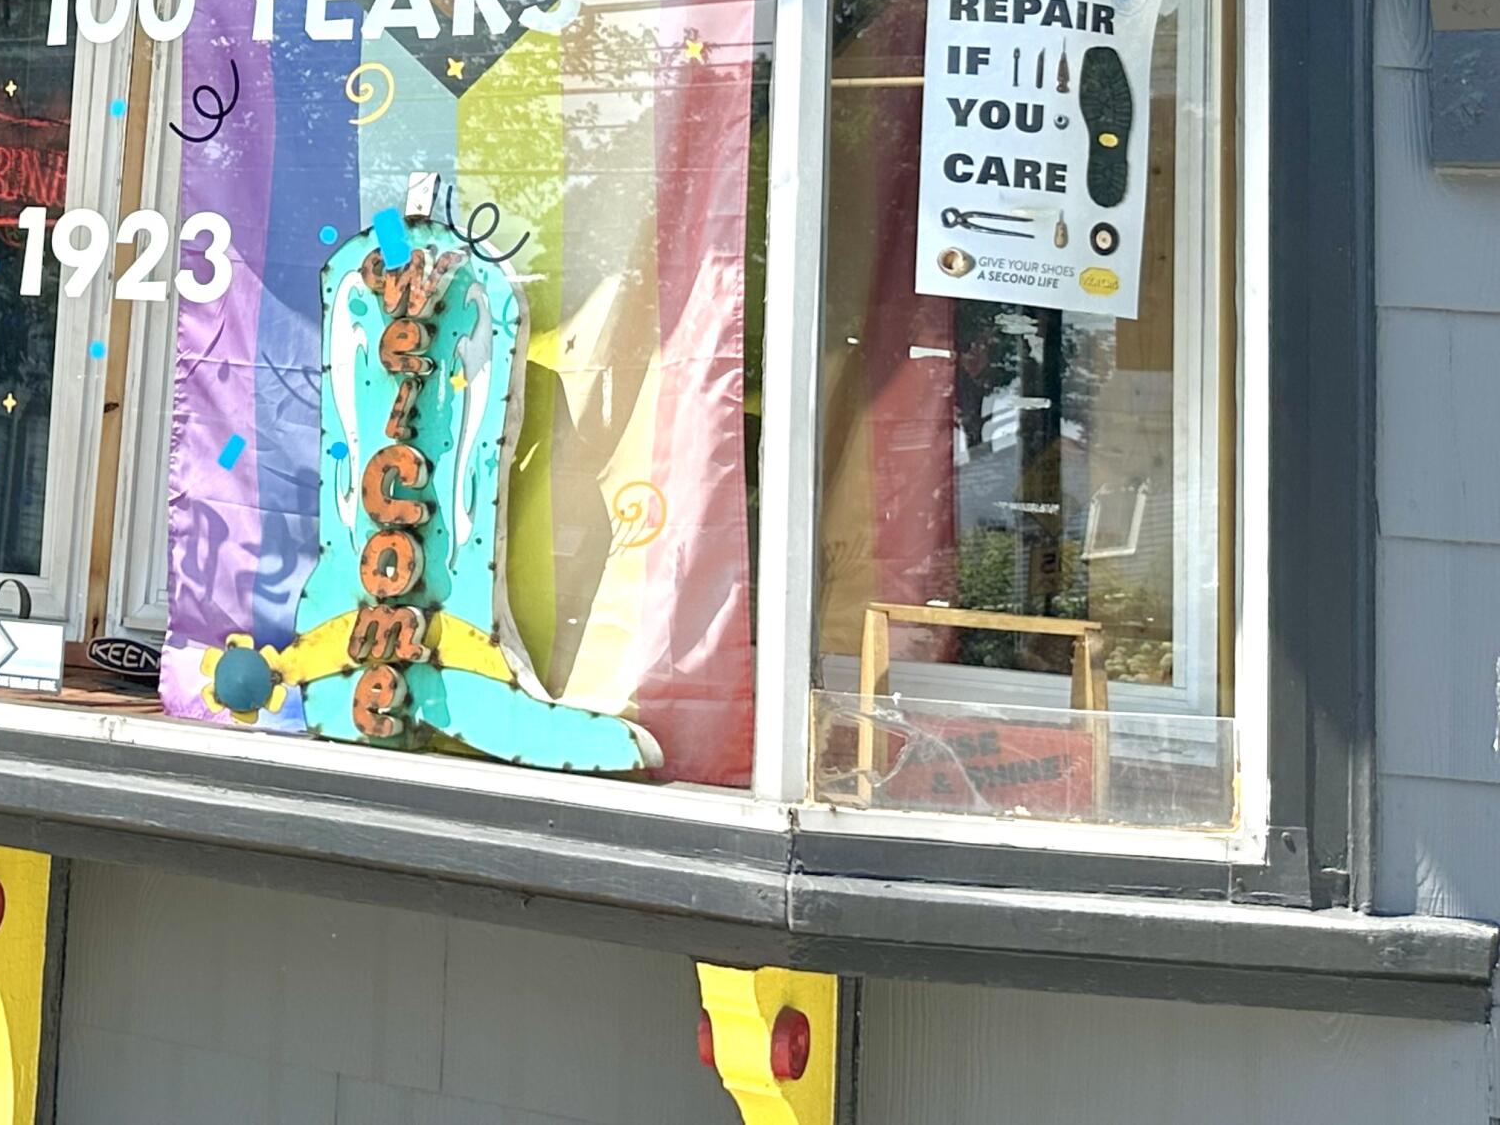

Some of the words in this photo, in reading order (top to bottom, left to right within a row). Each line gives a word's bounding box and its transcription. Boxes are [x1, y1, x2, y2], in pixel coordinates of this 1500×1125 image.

[946, 45, 991, 76] IF
[945, 97, 1045, 134] YOU
[942, 152, 1068, 194] CARE
[17, 205, 233, 304] 1923
[978, 255, 1006, 269] GIVE
[1008, 259, 1039, 273] YOUR
[1041, 263, 1076, 277] SHOES
[977, 270, 986, 281] A
[988, 270, 1036, 286] SECOND
[1037, 277, 1060, 289] LIFE
[90, 642, 161, 670] KEEN
